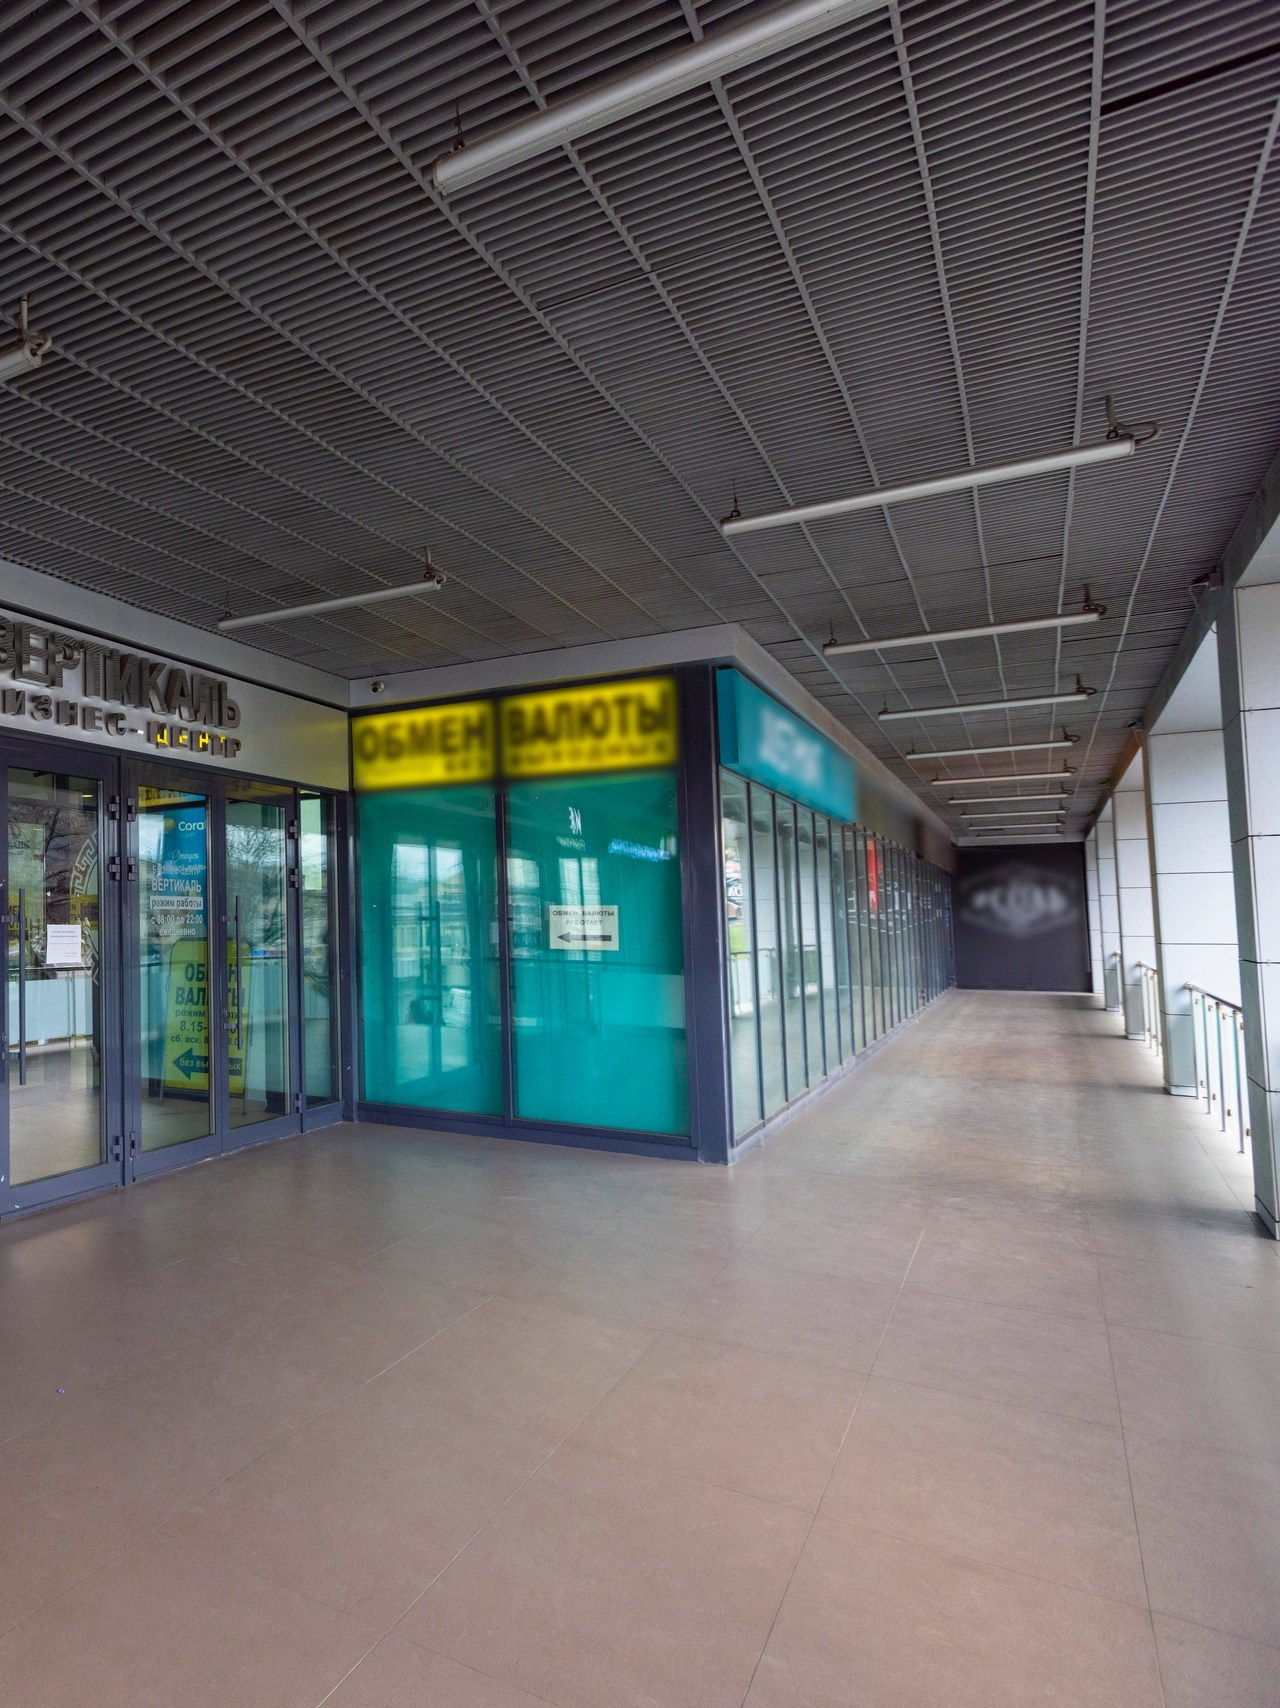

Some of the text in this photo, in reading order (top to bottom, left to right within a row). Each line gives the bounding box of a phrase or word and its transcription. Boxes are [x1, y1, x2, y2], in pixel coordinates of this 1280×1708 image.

[357, 689, 671, 764] ОБМЕН ВАЛЮТЫ
[152, 879, 202, 892] ВЕРТИКАЛЬ
[176, 899, 202, 909] работы
